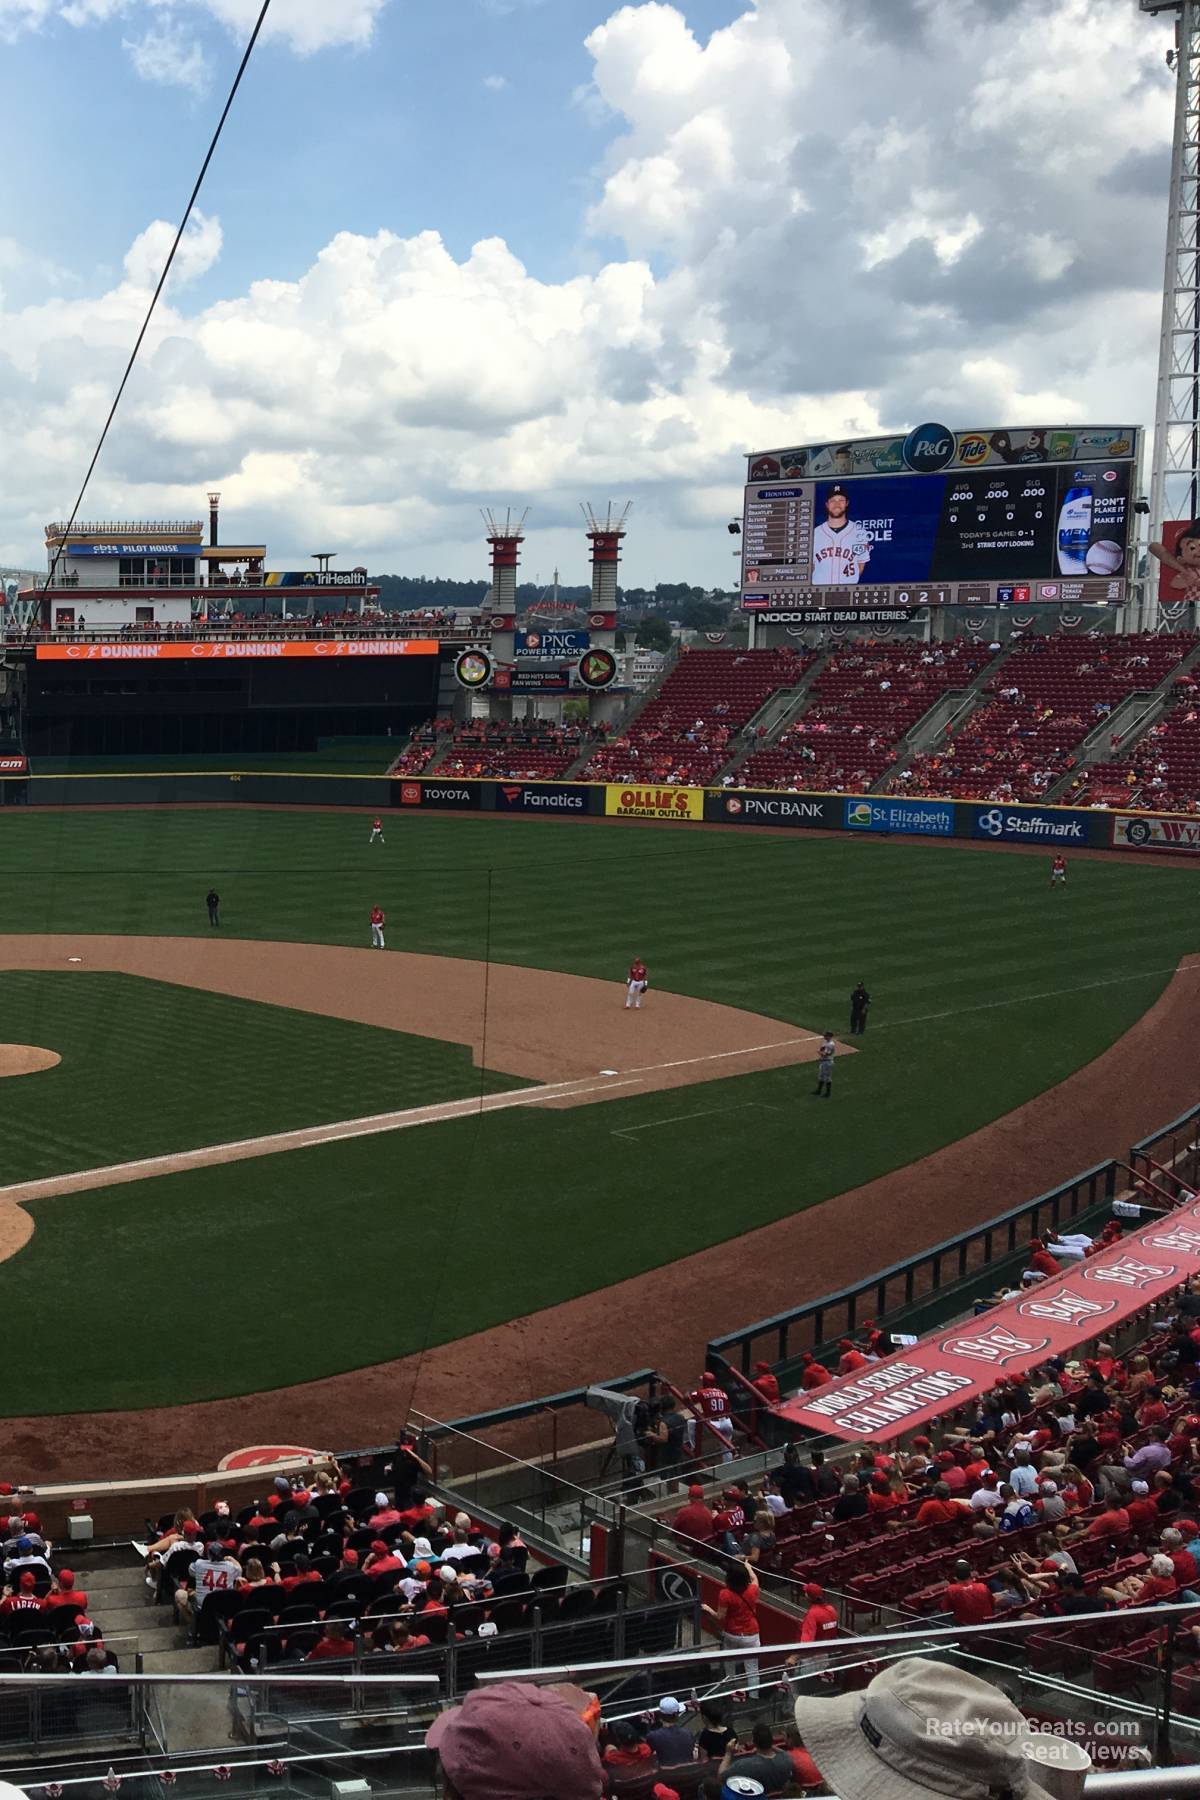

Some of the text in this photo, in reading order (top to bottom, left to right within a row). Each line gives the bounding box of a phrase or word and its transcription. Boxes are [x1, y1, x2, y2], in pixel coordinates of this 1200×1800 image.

[914, 440, 950, 457] P&G
[959, 441, 987, 460] Tide
[1094, 497, 1126, 507] DON'T
[855, 518, 895, 530] GERRIT
[959, 531, 991, 539] TODAY'S
[123, 544, 179, 553] PILOT HOUSE
[1009, 540, 1034, 548] LOOKING
[815, 547, 856, 563] ASTROS
[843, 563, 856, 577] 45
[315, 573, 366, 585] TriHealth
[758, 610, 909, 622] NOCO START DEAD BATTERIES.
[101, 641, 407, 657] DUNKIN' DUNKIN' DUNKIN'
[542, 635, 576, 648] PNC
[424, 789, 583, 807] TOYOTA Fanatics
[616, 807, 692, 818] BARGAIN OUTLET
[745, 800, 824, 817] PNC BANK
[890, 808, 950, 825] Elizabeth
[1006, 816, 1082, 837] Staffmark
[1133, 825, 1144, 834] 45
[1094, 1262, 1164, 1286] 1975
[1029, 1296, 1103, 1321] 1940
[953, 1335, 1033, 1361] 1919
[802, 1362, 926, 1416] WORLD SERIES
[711, 1400, 724, 1411] 90
[834, 1371, 973, 1434] CHAMPIONS
[203, 1571, 229, 1589] 44
[11, 1600, 41, 1611] LARKIN
